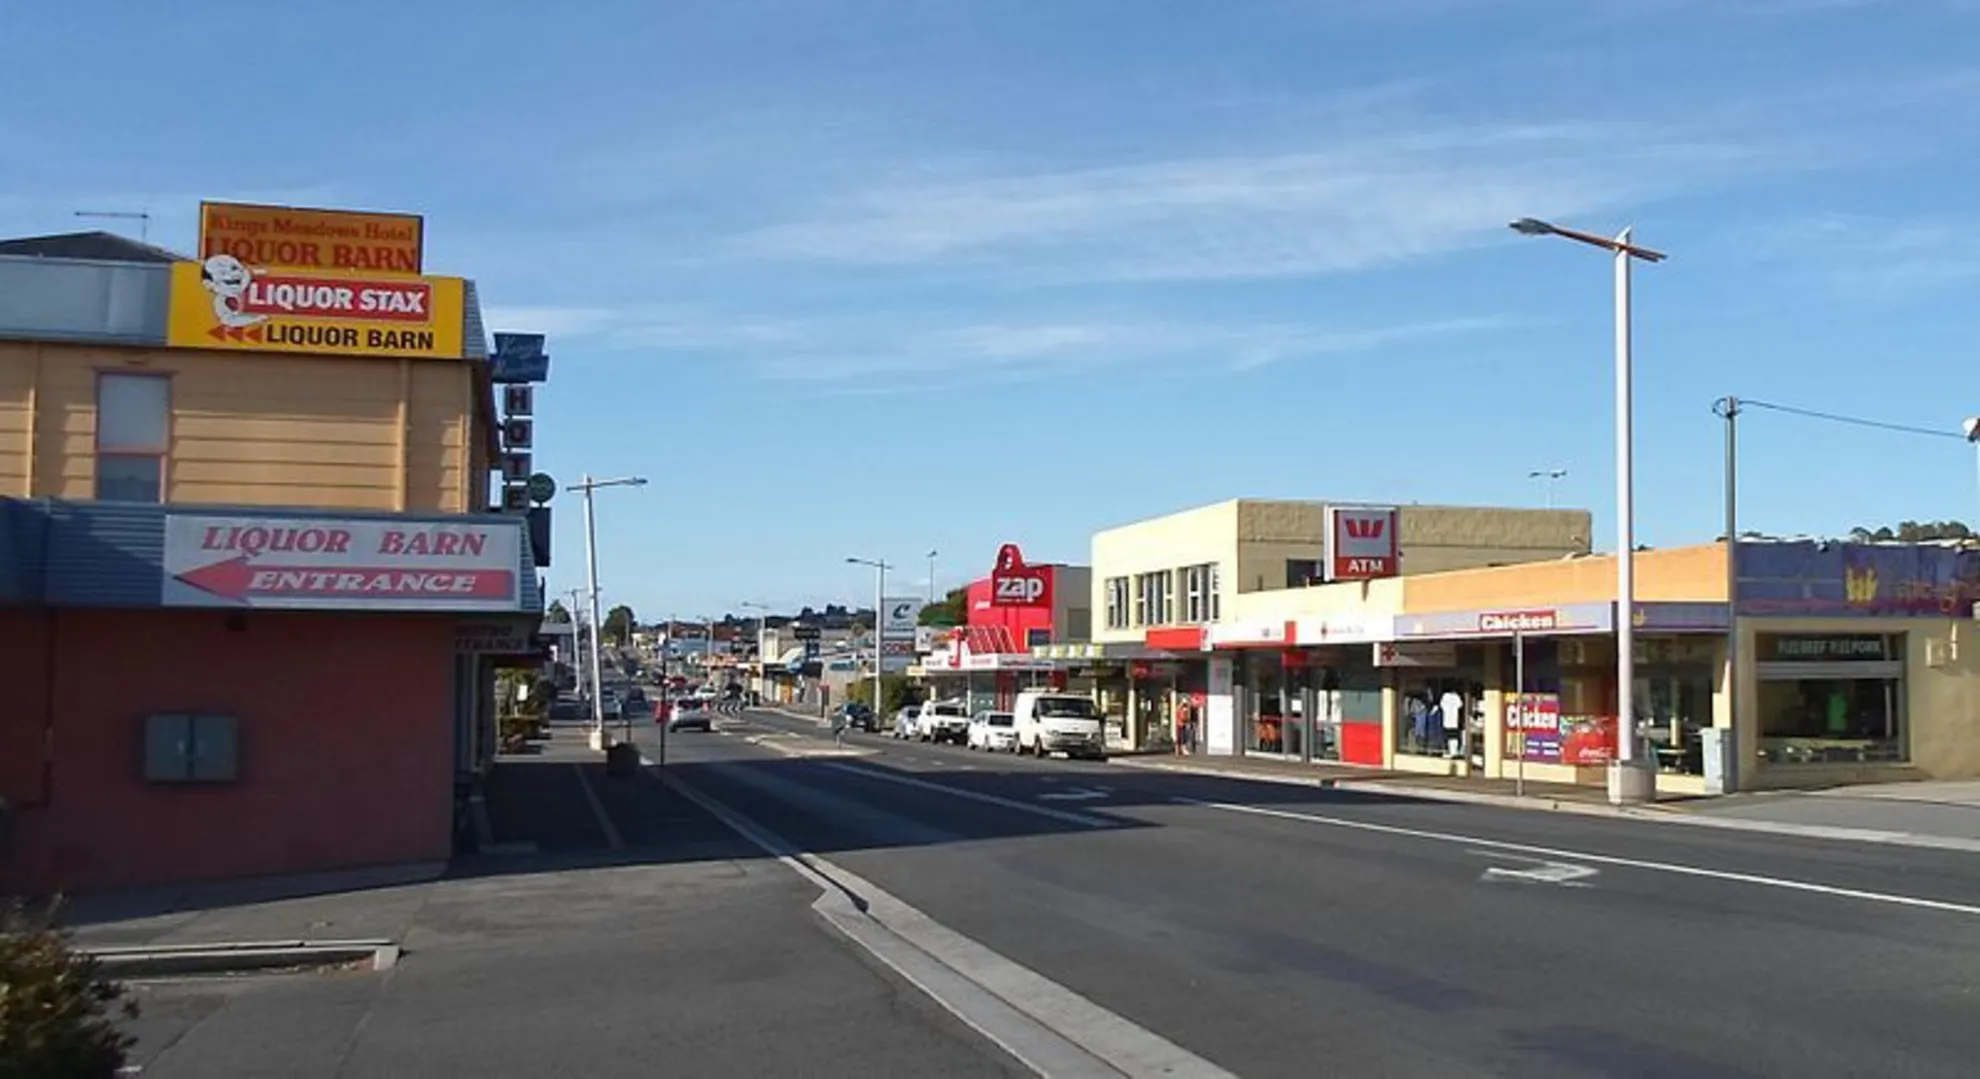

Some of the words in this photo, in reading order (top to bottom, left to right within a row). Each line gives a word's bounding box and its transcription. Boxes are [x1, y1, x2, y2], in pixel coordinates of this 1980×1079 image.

[274, 217, 360, 239] Meadows
[364, 221, 413, 242] Hotel
[205, 236, 320, 268] LIQUOR
[332, 244, 417, 275] BARN
[249, 283, 354, 311] LIQUOR
[359, 289, 425, 313] STAX
[267, 323, 359, 347] LIQUOR
[368, 331, 434, 350] BARN
[201, 526, 351, 557] LIQUOR
[377, 531, 489, 557] BARN
[1347, 558, 1384, 573] ATM
[249, 570, 478, 593] ENTRANCE
[996, 576, 1044, 603] zap
[1481, 613, 1554, 630] Chicken
